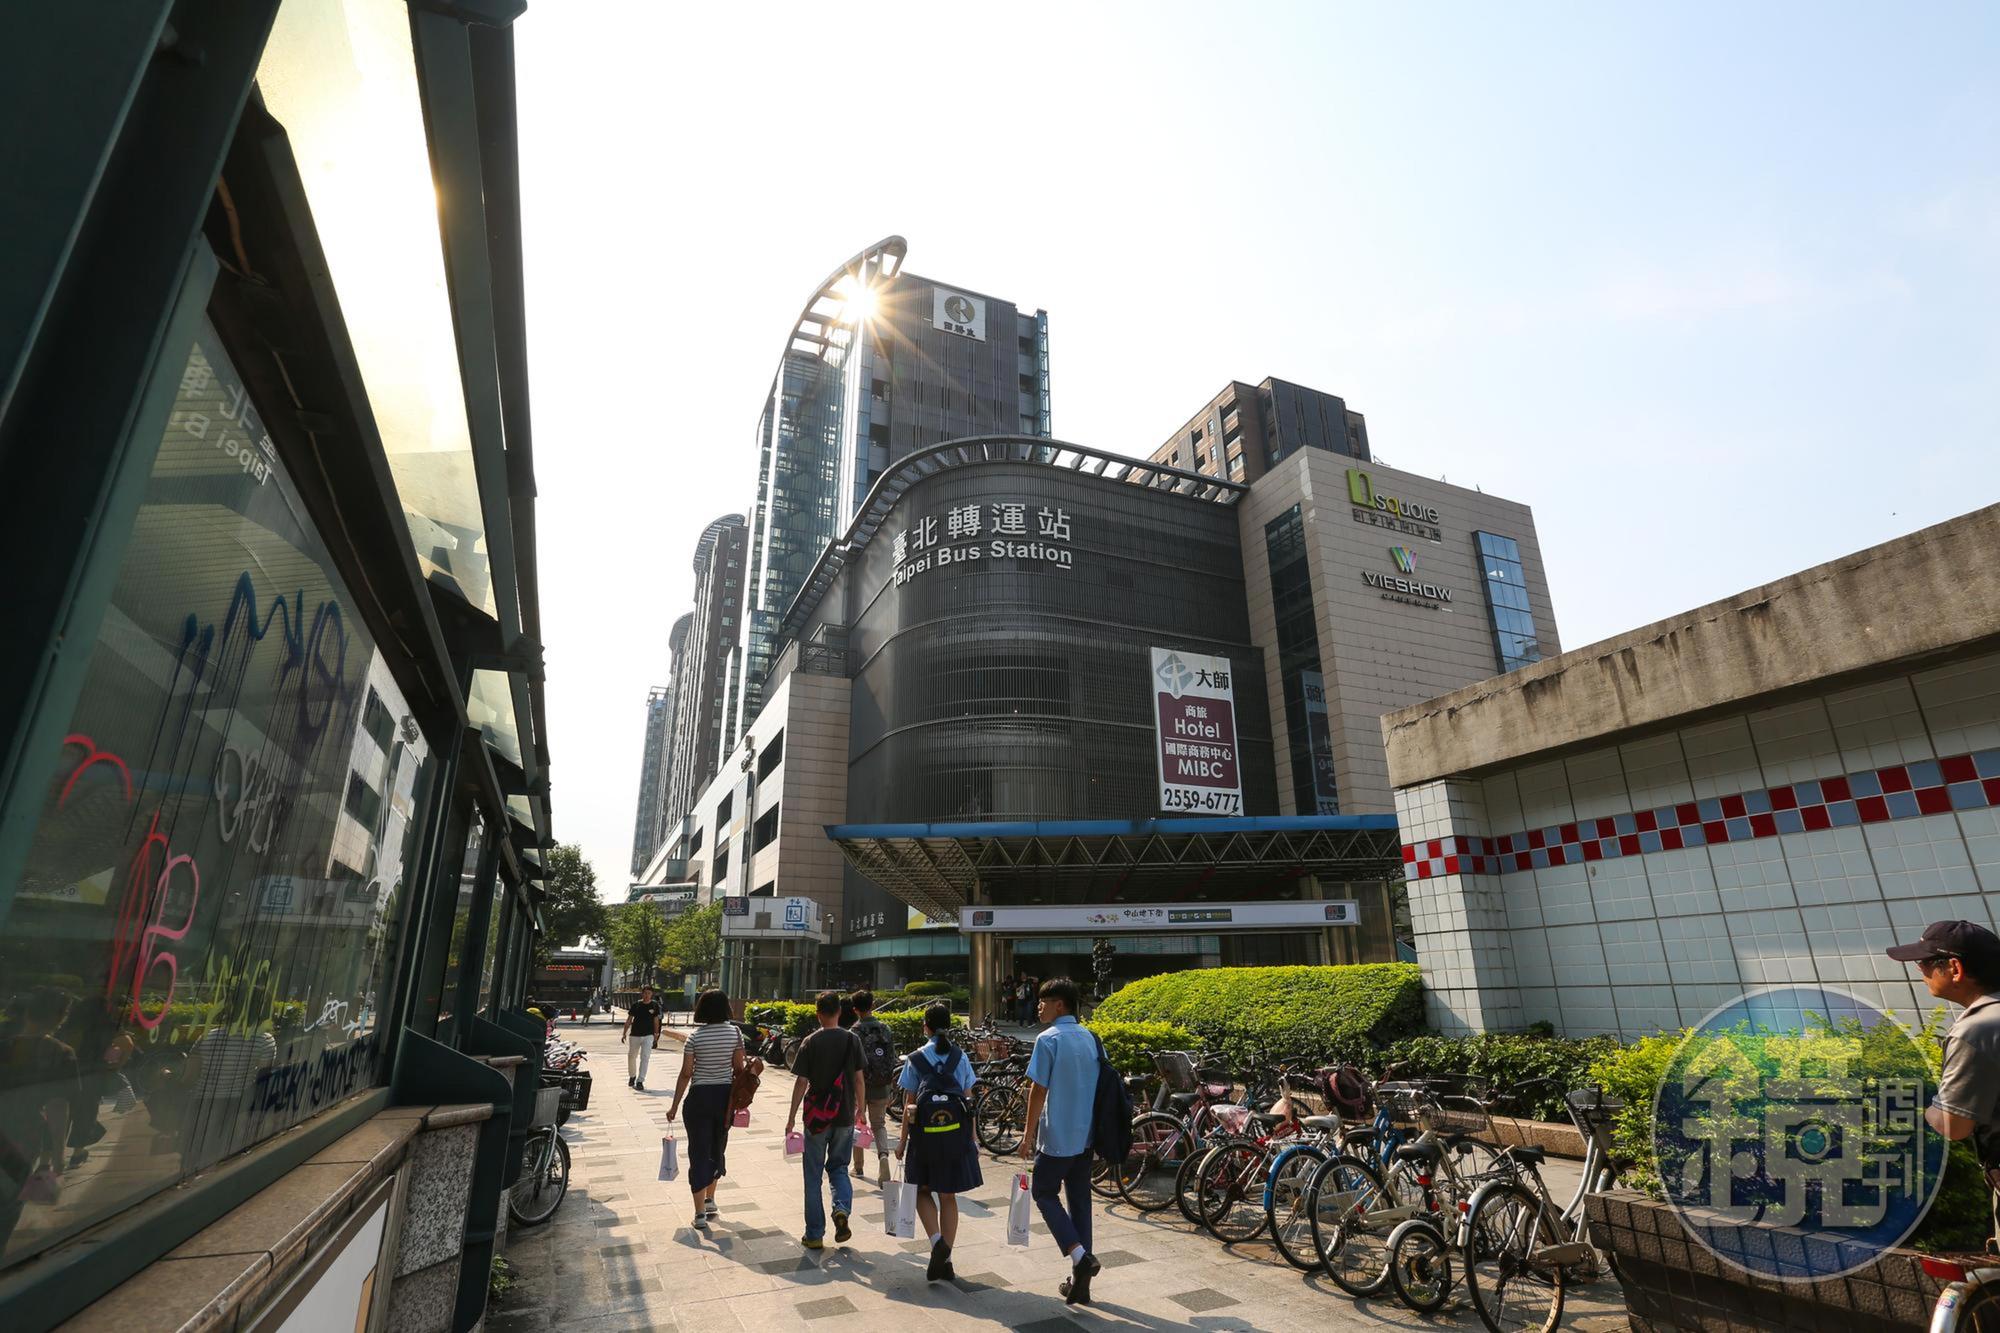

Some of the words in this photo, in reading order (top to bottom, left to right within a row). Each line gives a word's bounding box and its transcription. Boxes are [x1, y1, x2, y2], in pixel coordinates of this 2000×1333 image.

[892, 503, 1071, 568] 臺北轉運站
[893, 553, 931, 589] Taipei
[938, 547, 981, 566] Bus
[991, 540, 1072, 565] Station
[1363, 571, 1452, 602] VIESHOW
[1195, 669, 1230, 691] 大師
[1184, 705, 1208, 719] 商旅
[1174, 718, 1221, 738] Hotel
[1165, 742, 1232, 761] 國際商務中心
[1178, 759, 1224, 778] MIBC
[1164, 788, 1240, 812] 2559-6777
